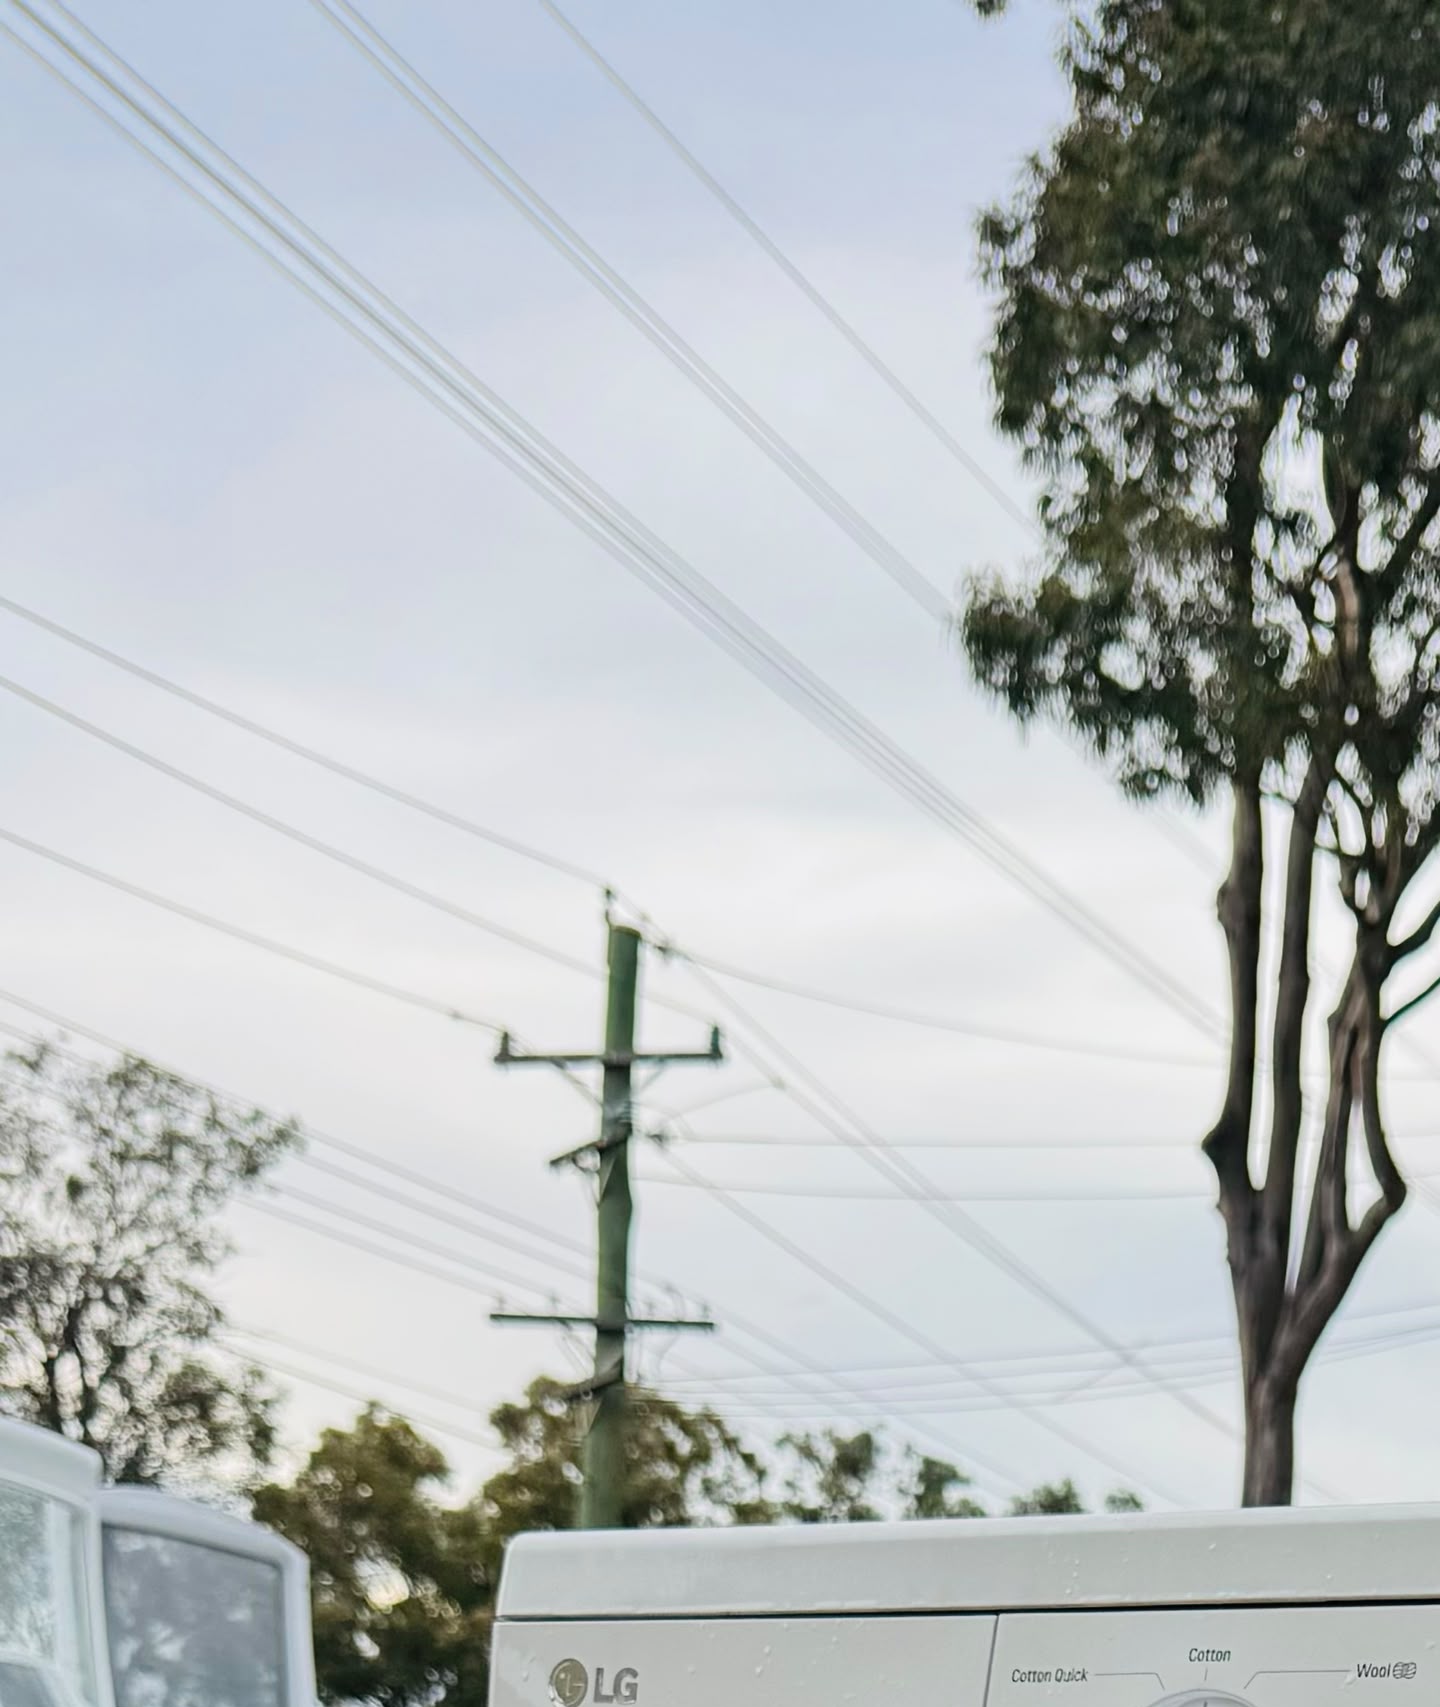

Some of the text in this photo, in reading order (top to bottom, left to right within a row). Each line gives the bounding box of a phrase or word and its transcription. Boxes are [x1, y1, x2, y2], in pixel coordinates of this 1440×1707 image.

[1188, 1647, 1231, 1663] Cotton
[1011, 1667, 1089, 1684] Cotton Quick
[1356, 1662, 1391, 1679] Wool
[593, 1667, 639, 1704] LG
